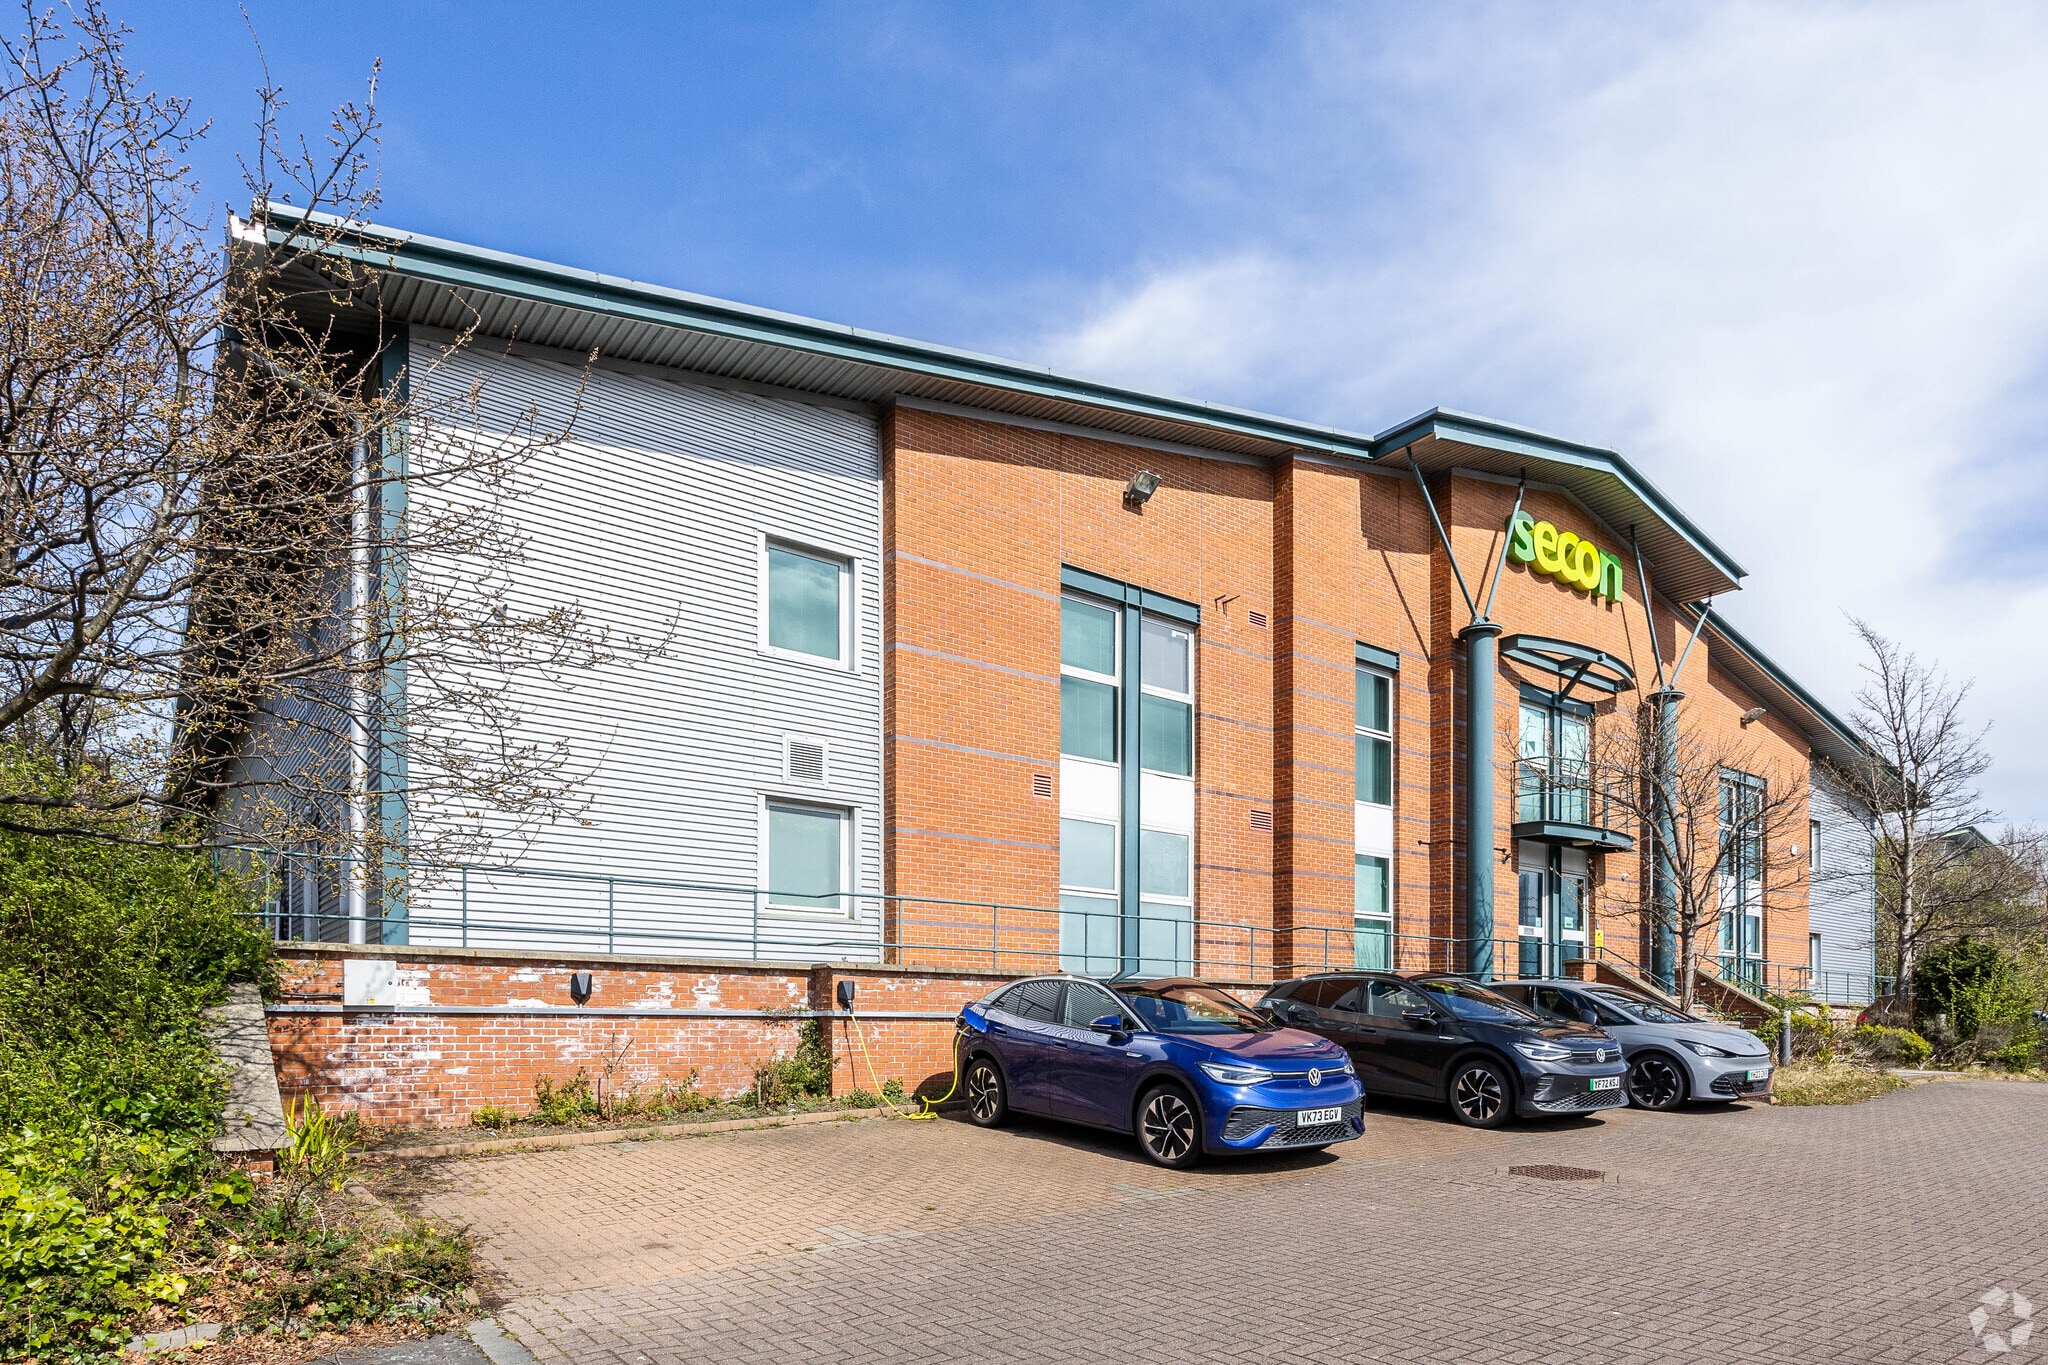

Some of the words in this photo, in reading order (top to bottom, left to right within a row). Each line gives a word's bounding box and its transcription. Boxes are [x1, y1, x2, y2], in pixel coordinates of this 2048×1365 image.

[1508, 510, 1623, 603] secon
[1594, 1079, 1609, 1089] YF72
[1301, 1110, 1323, 1123] VK73
[1324, 1109, 1339, 1121] EGV
